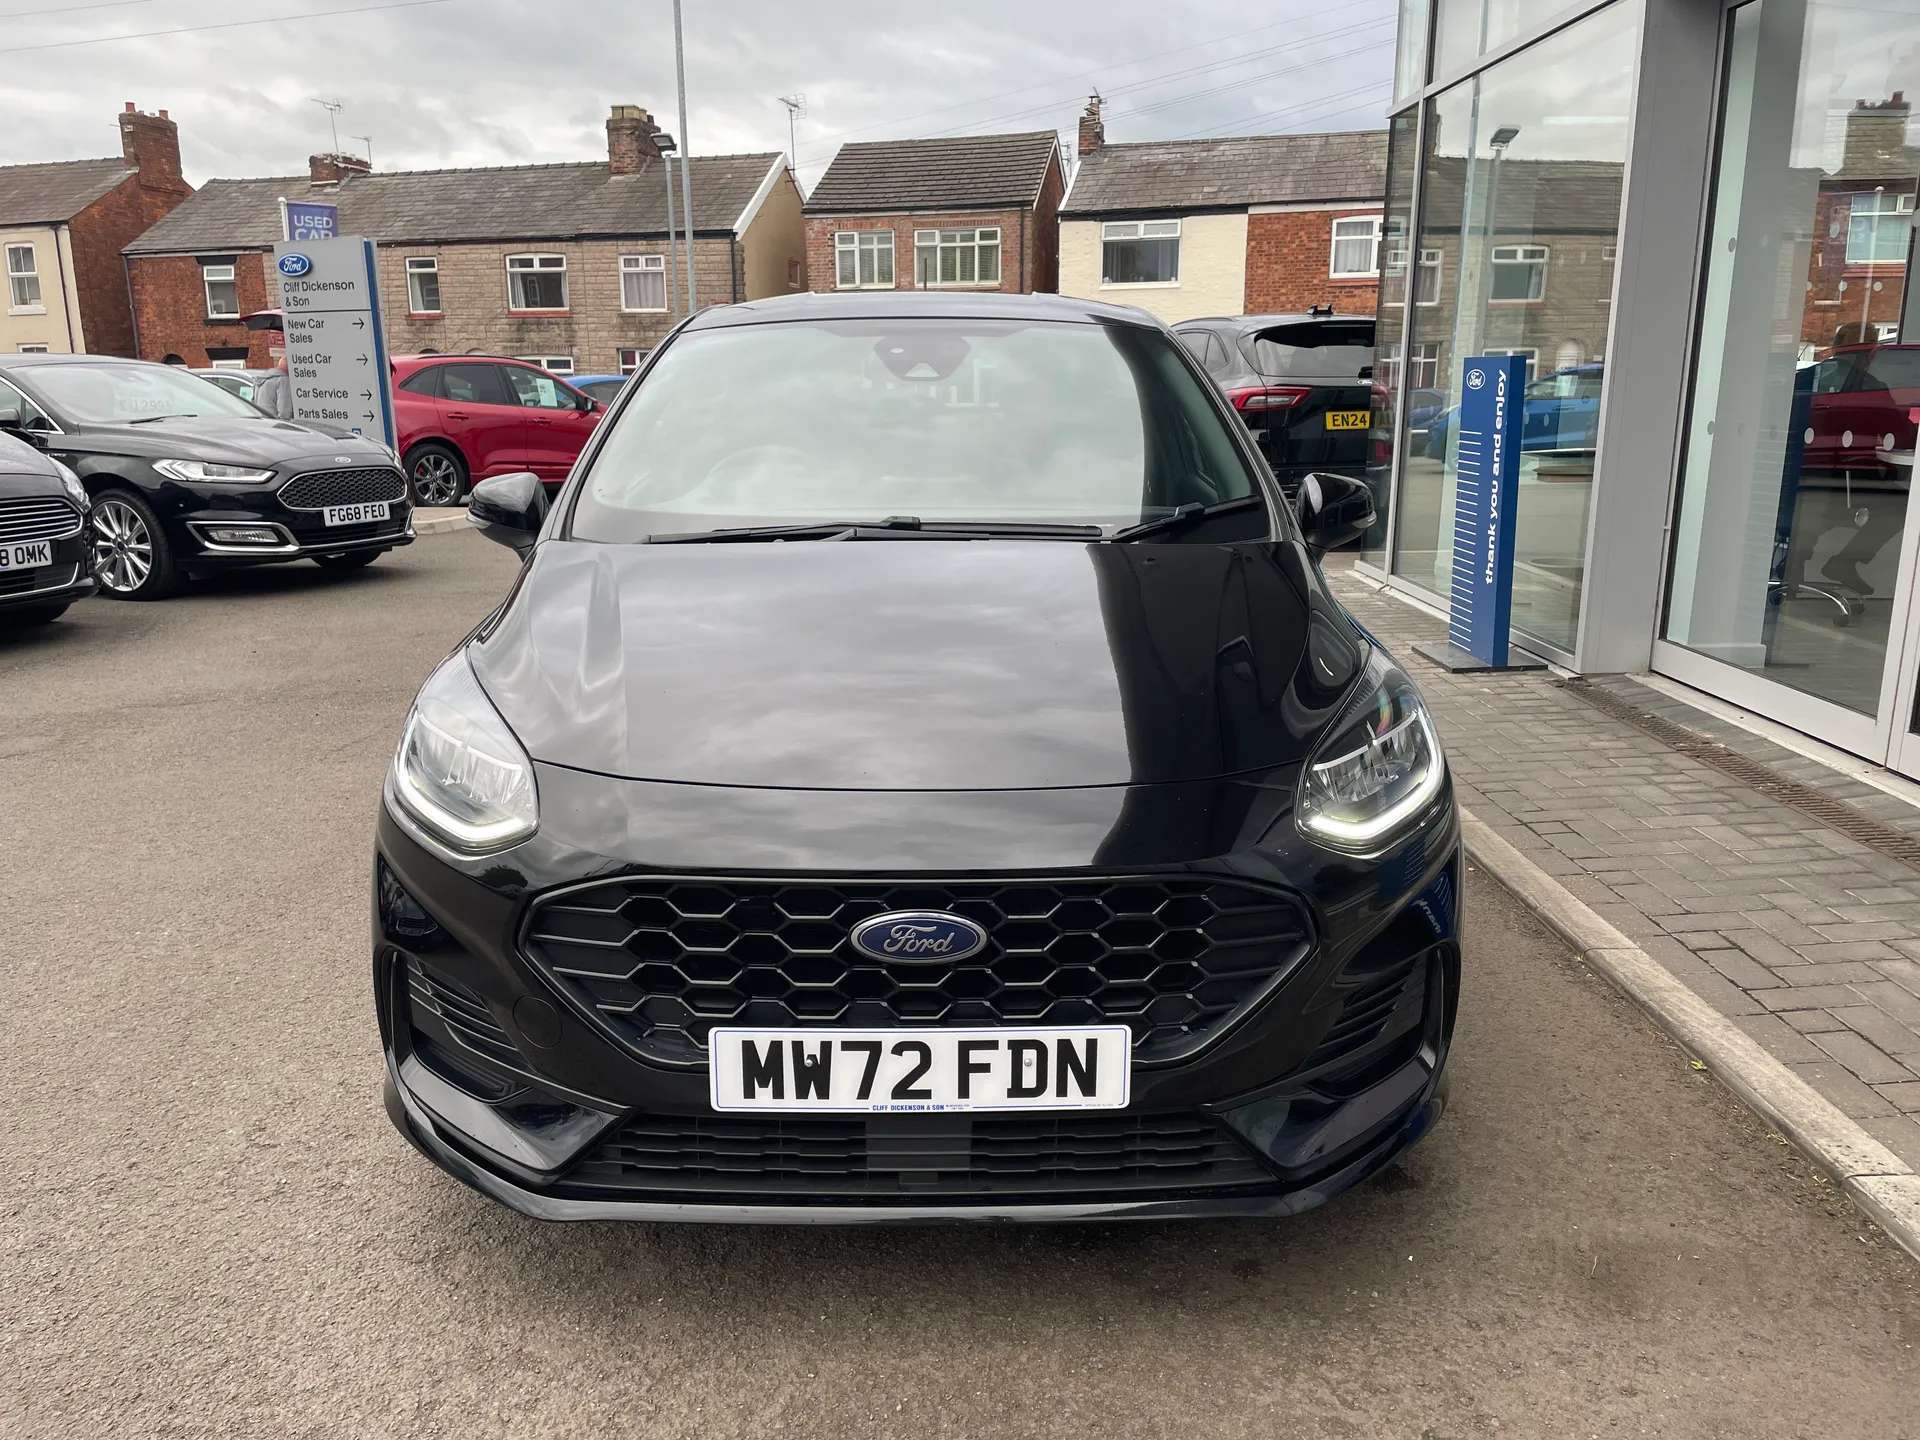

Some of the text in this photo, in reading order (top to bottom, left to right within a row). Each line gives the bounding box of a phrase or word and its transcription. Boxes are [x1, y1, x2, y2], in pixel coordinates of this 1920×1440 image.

[293, 214, 333, 229] USED
[283, 280, 355, 293] Cliff Dickenson
[285, 296, 310, 307] & Son
[288, 318, 325, 330] New Car
[289, 333, 313, 344] Sales
[292, 353, 332, 364] Used Car
[293, 367, 317, 378] Sales
[296, 388, 349, 399] Car Service
[298, 408, 349, 419] Parts Sales
[1332, 413, 1367, 427] EN24
[1485, 369, 1507, 585] thank you and enjoy
[329, 504, 385, 523] FG68 FEO
[14, 543, 48, 565] OMK
[883, 924, 955, 953] Ford
[741, 1038, 1098, 1101] MW72 FDN
